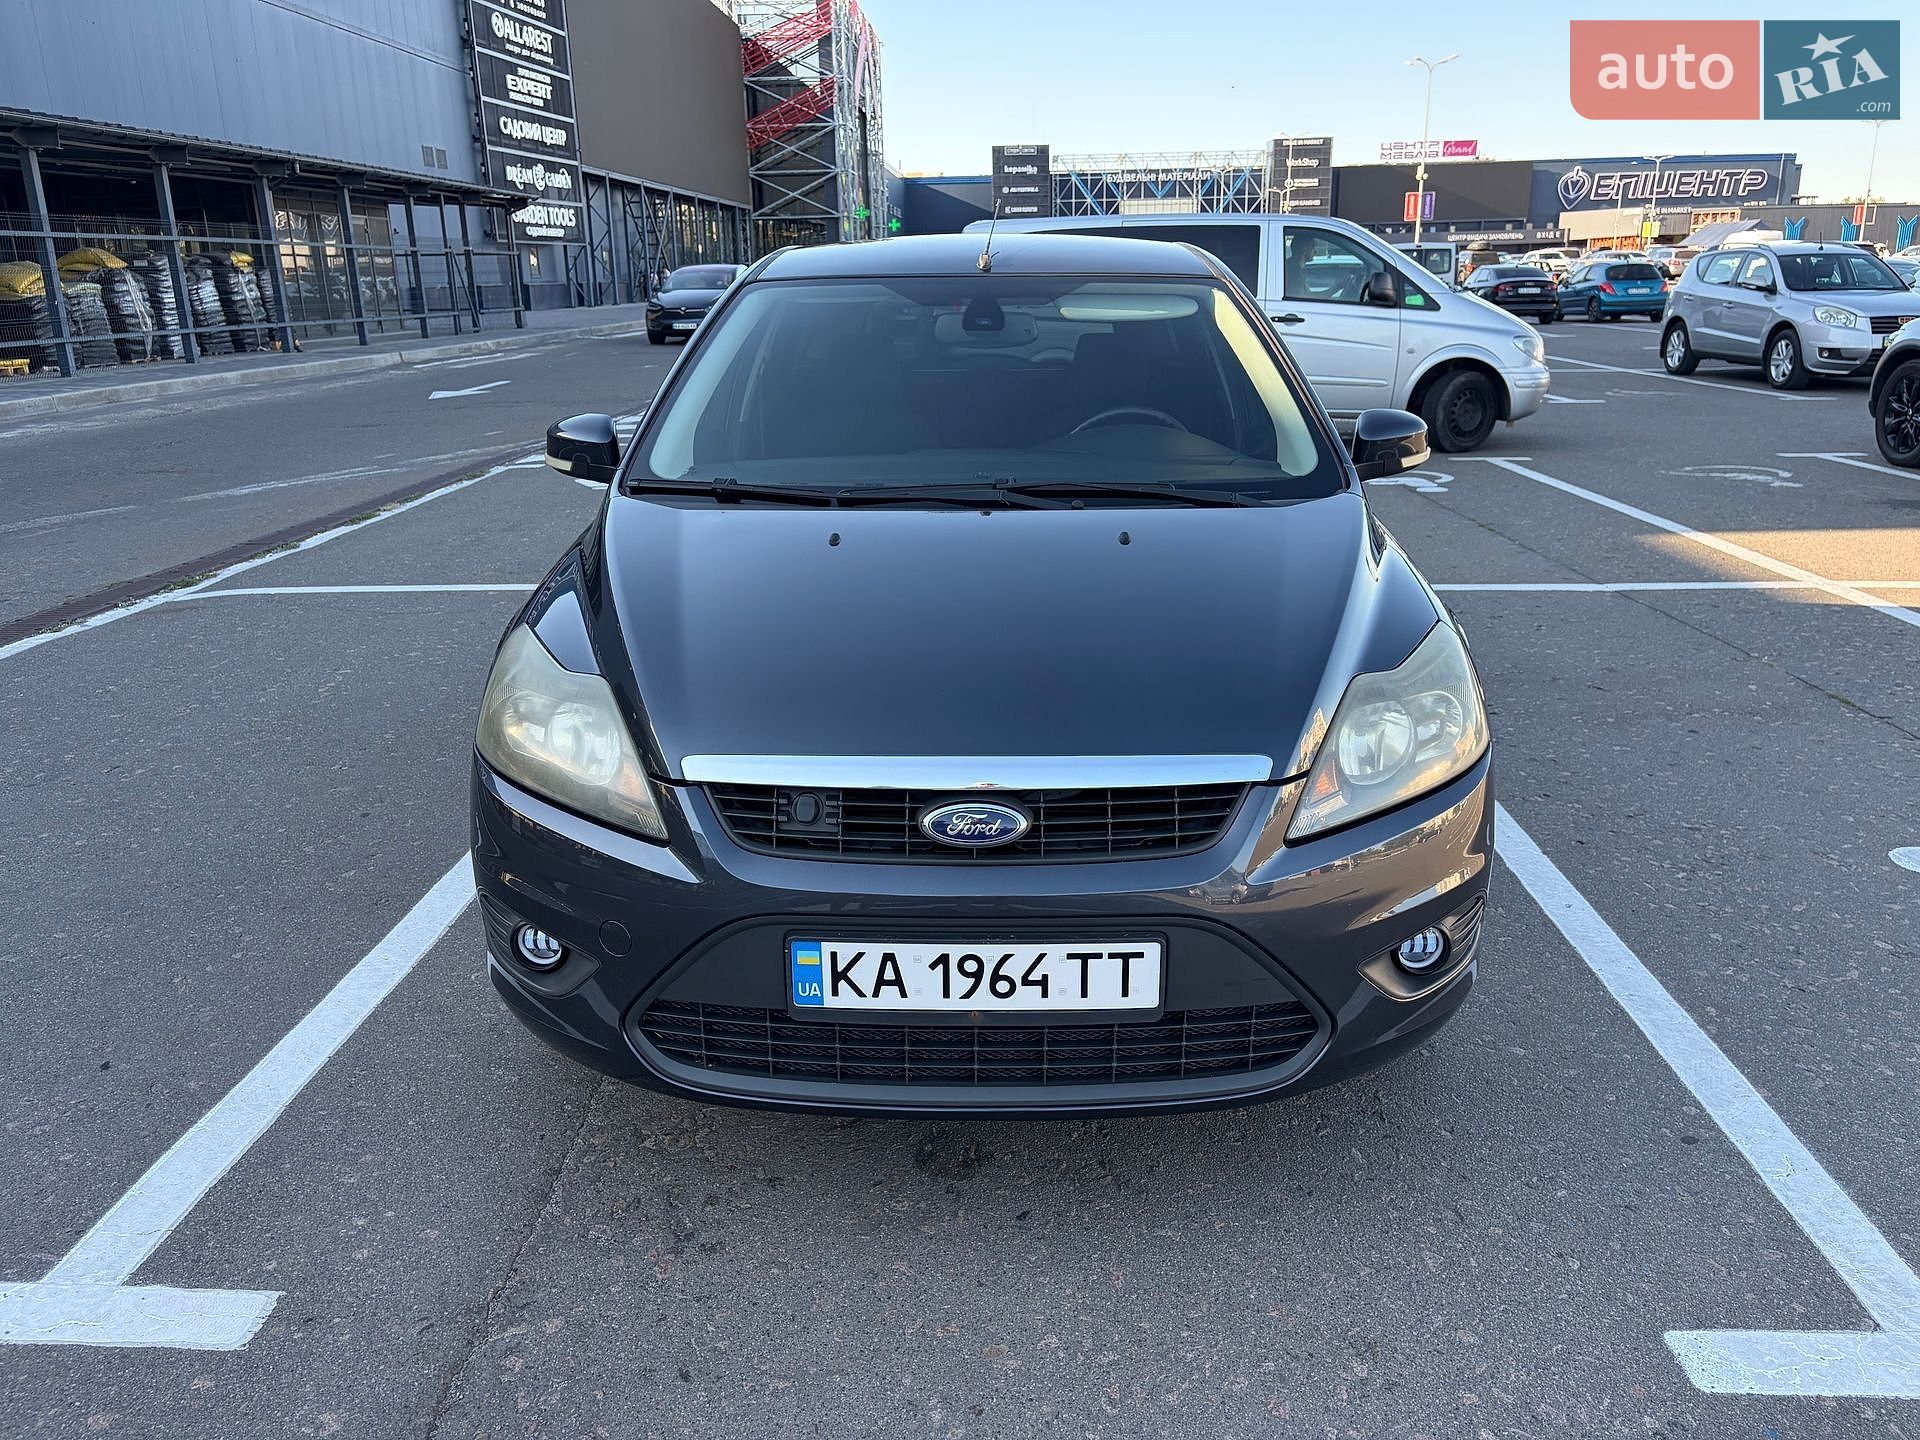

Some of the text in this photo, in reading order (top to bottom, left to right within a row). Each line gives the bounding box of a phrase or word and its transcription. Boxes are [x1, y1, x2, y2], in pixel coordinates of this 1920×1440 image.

[505, 74, 552, 100] EXPERT
[499, 116, 567, 146] САДОВИЙ ЦЕНТР
[1380, 141, 1440, 151] ЦЕНТР
[1380, 150, 1440, 160] МЕБЛІВ
[1443, 140, 1477, 155] Grand
[1106, 171, 1211, 184] БУДІВЕЛЬНІ МАТЕРІАЛИ
[1589, 168, 1769, 202] ЕПІЦЕНТР
[511, 204, 576, 227] GARDEN TOOLS
[946, 812, 1001, 836] Ford
[829, 950, 1145, 1000] KA 1964 TT
[797, 982, 822, 997] UA
